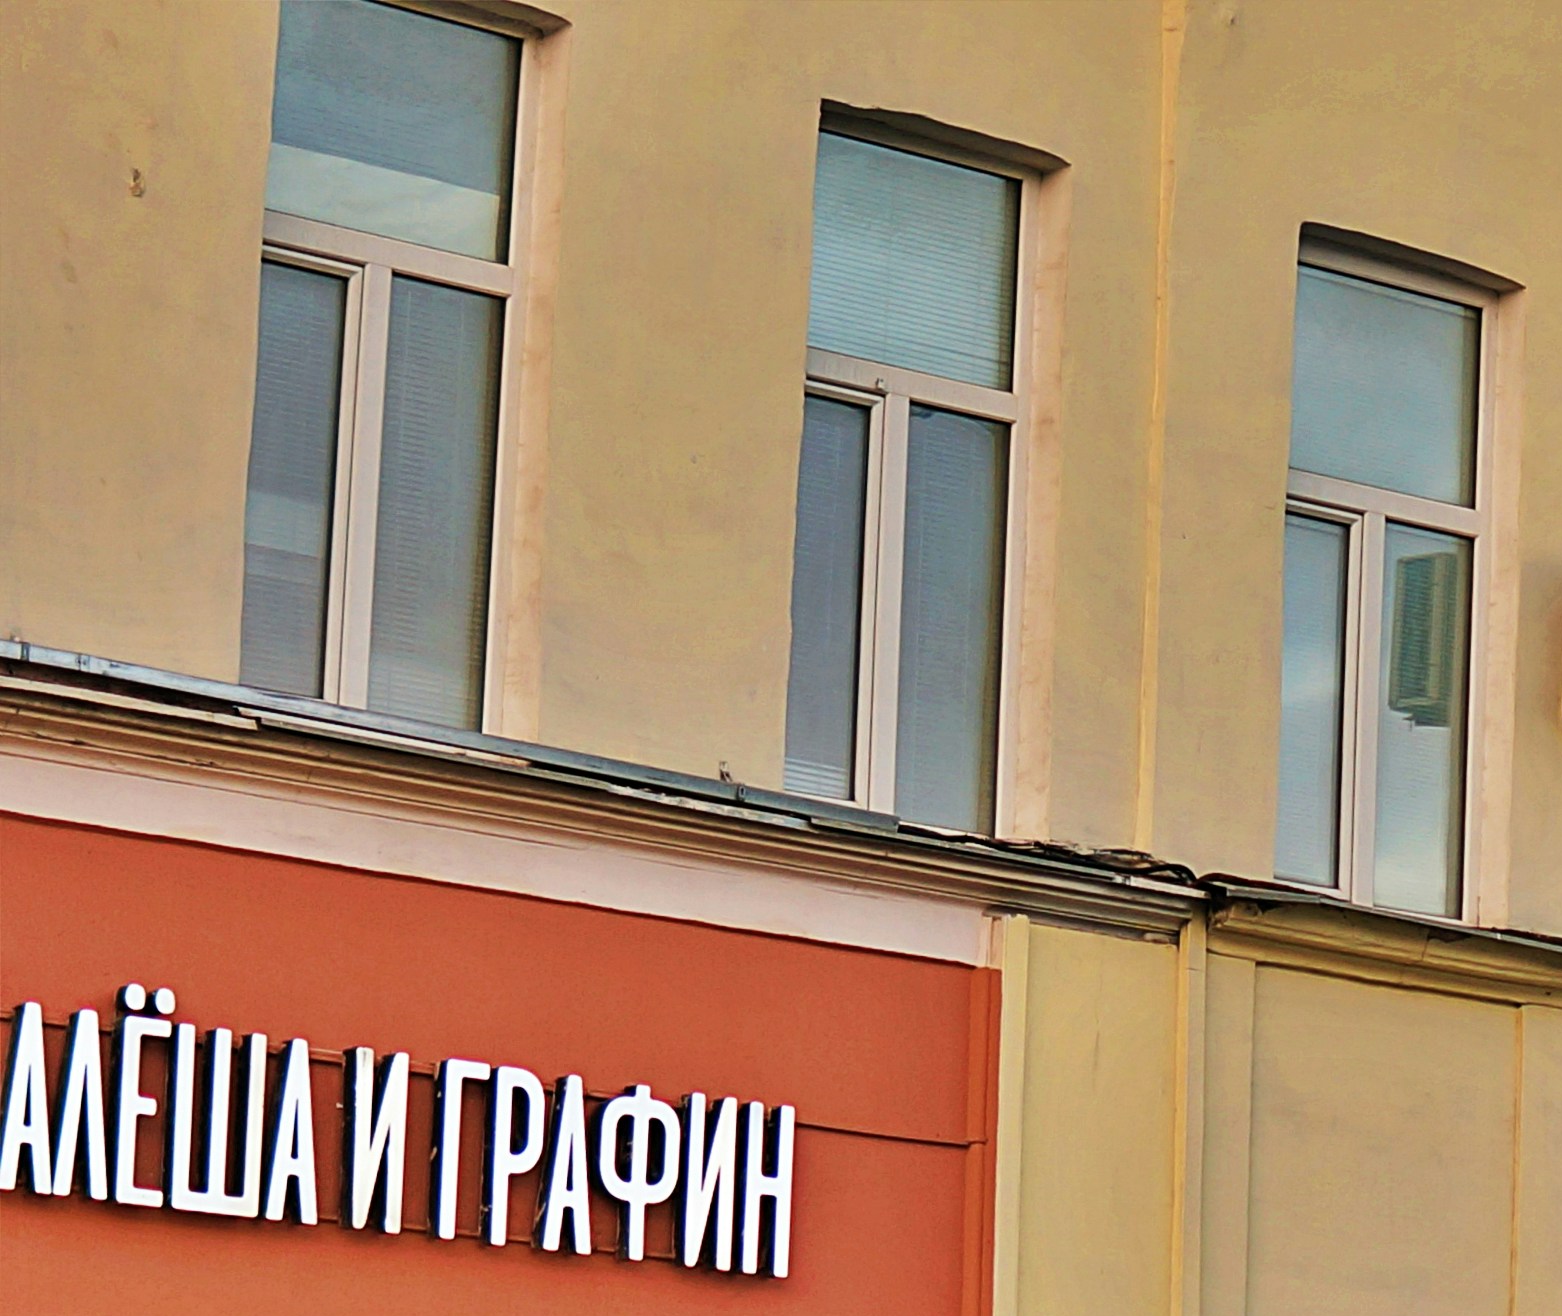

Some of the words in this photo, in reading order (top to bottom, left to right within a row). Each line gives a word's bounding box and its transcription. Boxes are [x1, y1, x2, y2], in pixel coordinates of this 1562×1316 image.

[0, 983, 319, 1226] АЛЁША
[347, 1046, 410, 1235] И
[435, 1059, 798, 1279] ГРАФИН
